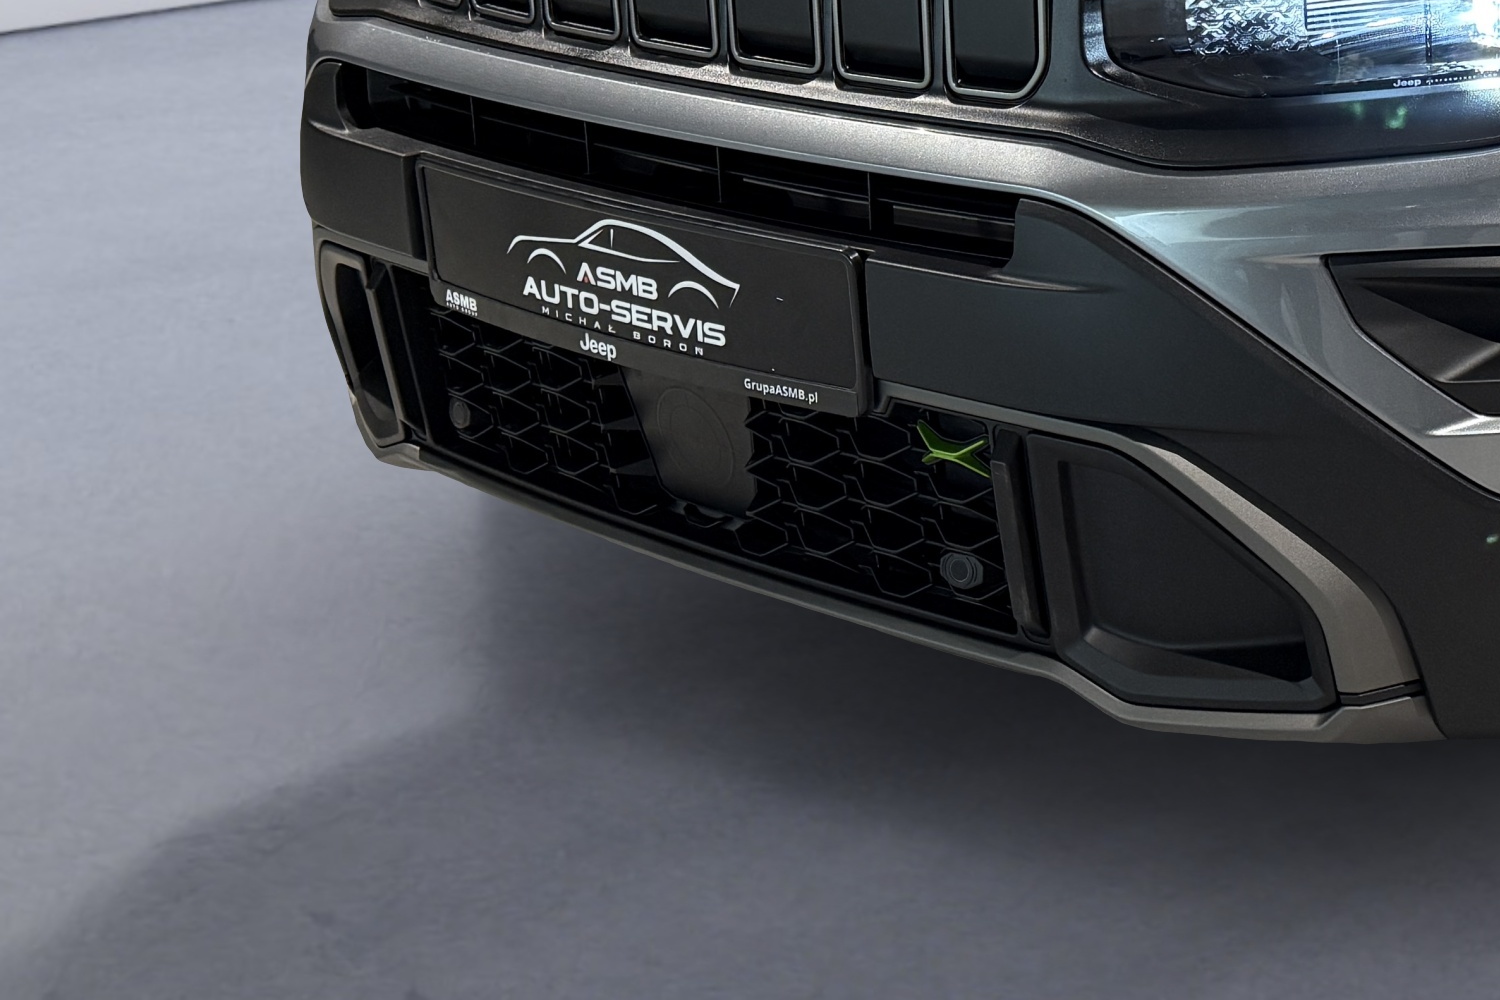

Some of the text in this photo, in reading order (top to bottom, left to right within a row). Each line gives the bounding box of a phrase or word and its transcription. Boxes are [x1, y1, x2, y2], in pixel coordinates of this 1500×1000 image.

[1393, 79, 1422, 88] Jeep
[576, 262, 658, 300] ASMB
[445, 288, 478, 312] ASMB
[522, 275, 727, 347] AUTO-SERVIS
[541, 305, 617, 334] MICHAŁ
[579, 332, 618, 362] Jeep
[743, 377, 819, 405] GrupaASMB.pl
